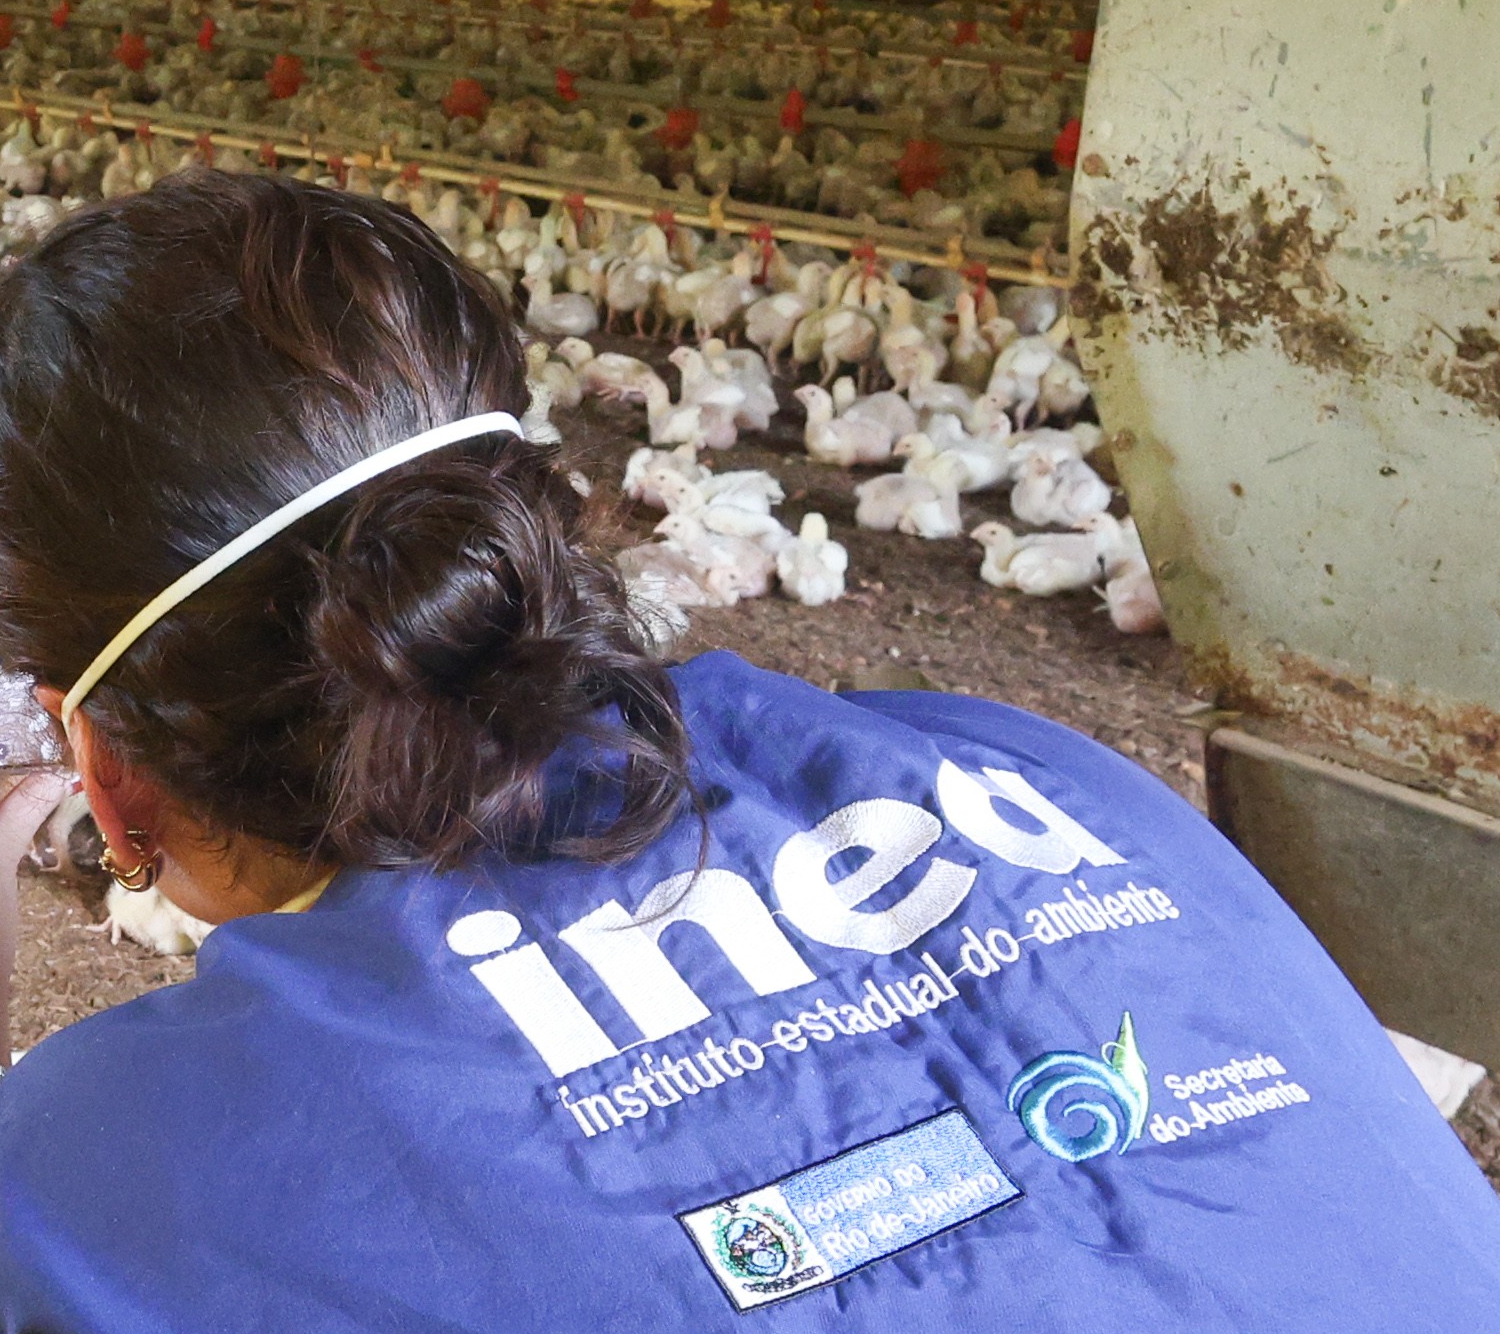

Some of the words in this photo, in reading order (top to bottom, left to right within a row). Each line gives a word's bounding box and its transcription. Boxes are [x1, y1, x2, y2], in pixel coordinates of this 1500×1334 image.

[446, 758, 1128, 1077] inea
[557, 1036, 765, 1138] instituto
[771, 951, 960, 1053] estadual
[959, 925, 1021, 979] do
[1024, 879, 1181, 945] ambiente
[1149, 1113, 1192, 1144] do
[1190, 1079, 1311, 1130] Ambiente
[1163, 1052, 1287, 1100] Secretaria
[803, 1175, 894, 1226] GOVERNO
[893, 1162, 928, 1191] DO
[821, 1222, 871, 1260] Rio
[868, 1210, 905, 1241] de
[904, 1173, 1001, 1224] Janeiro
